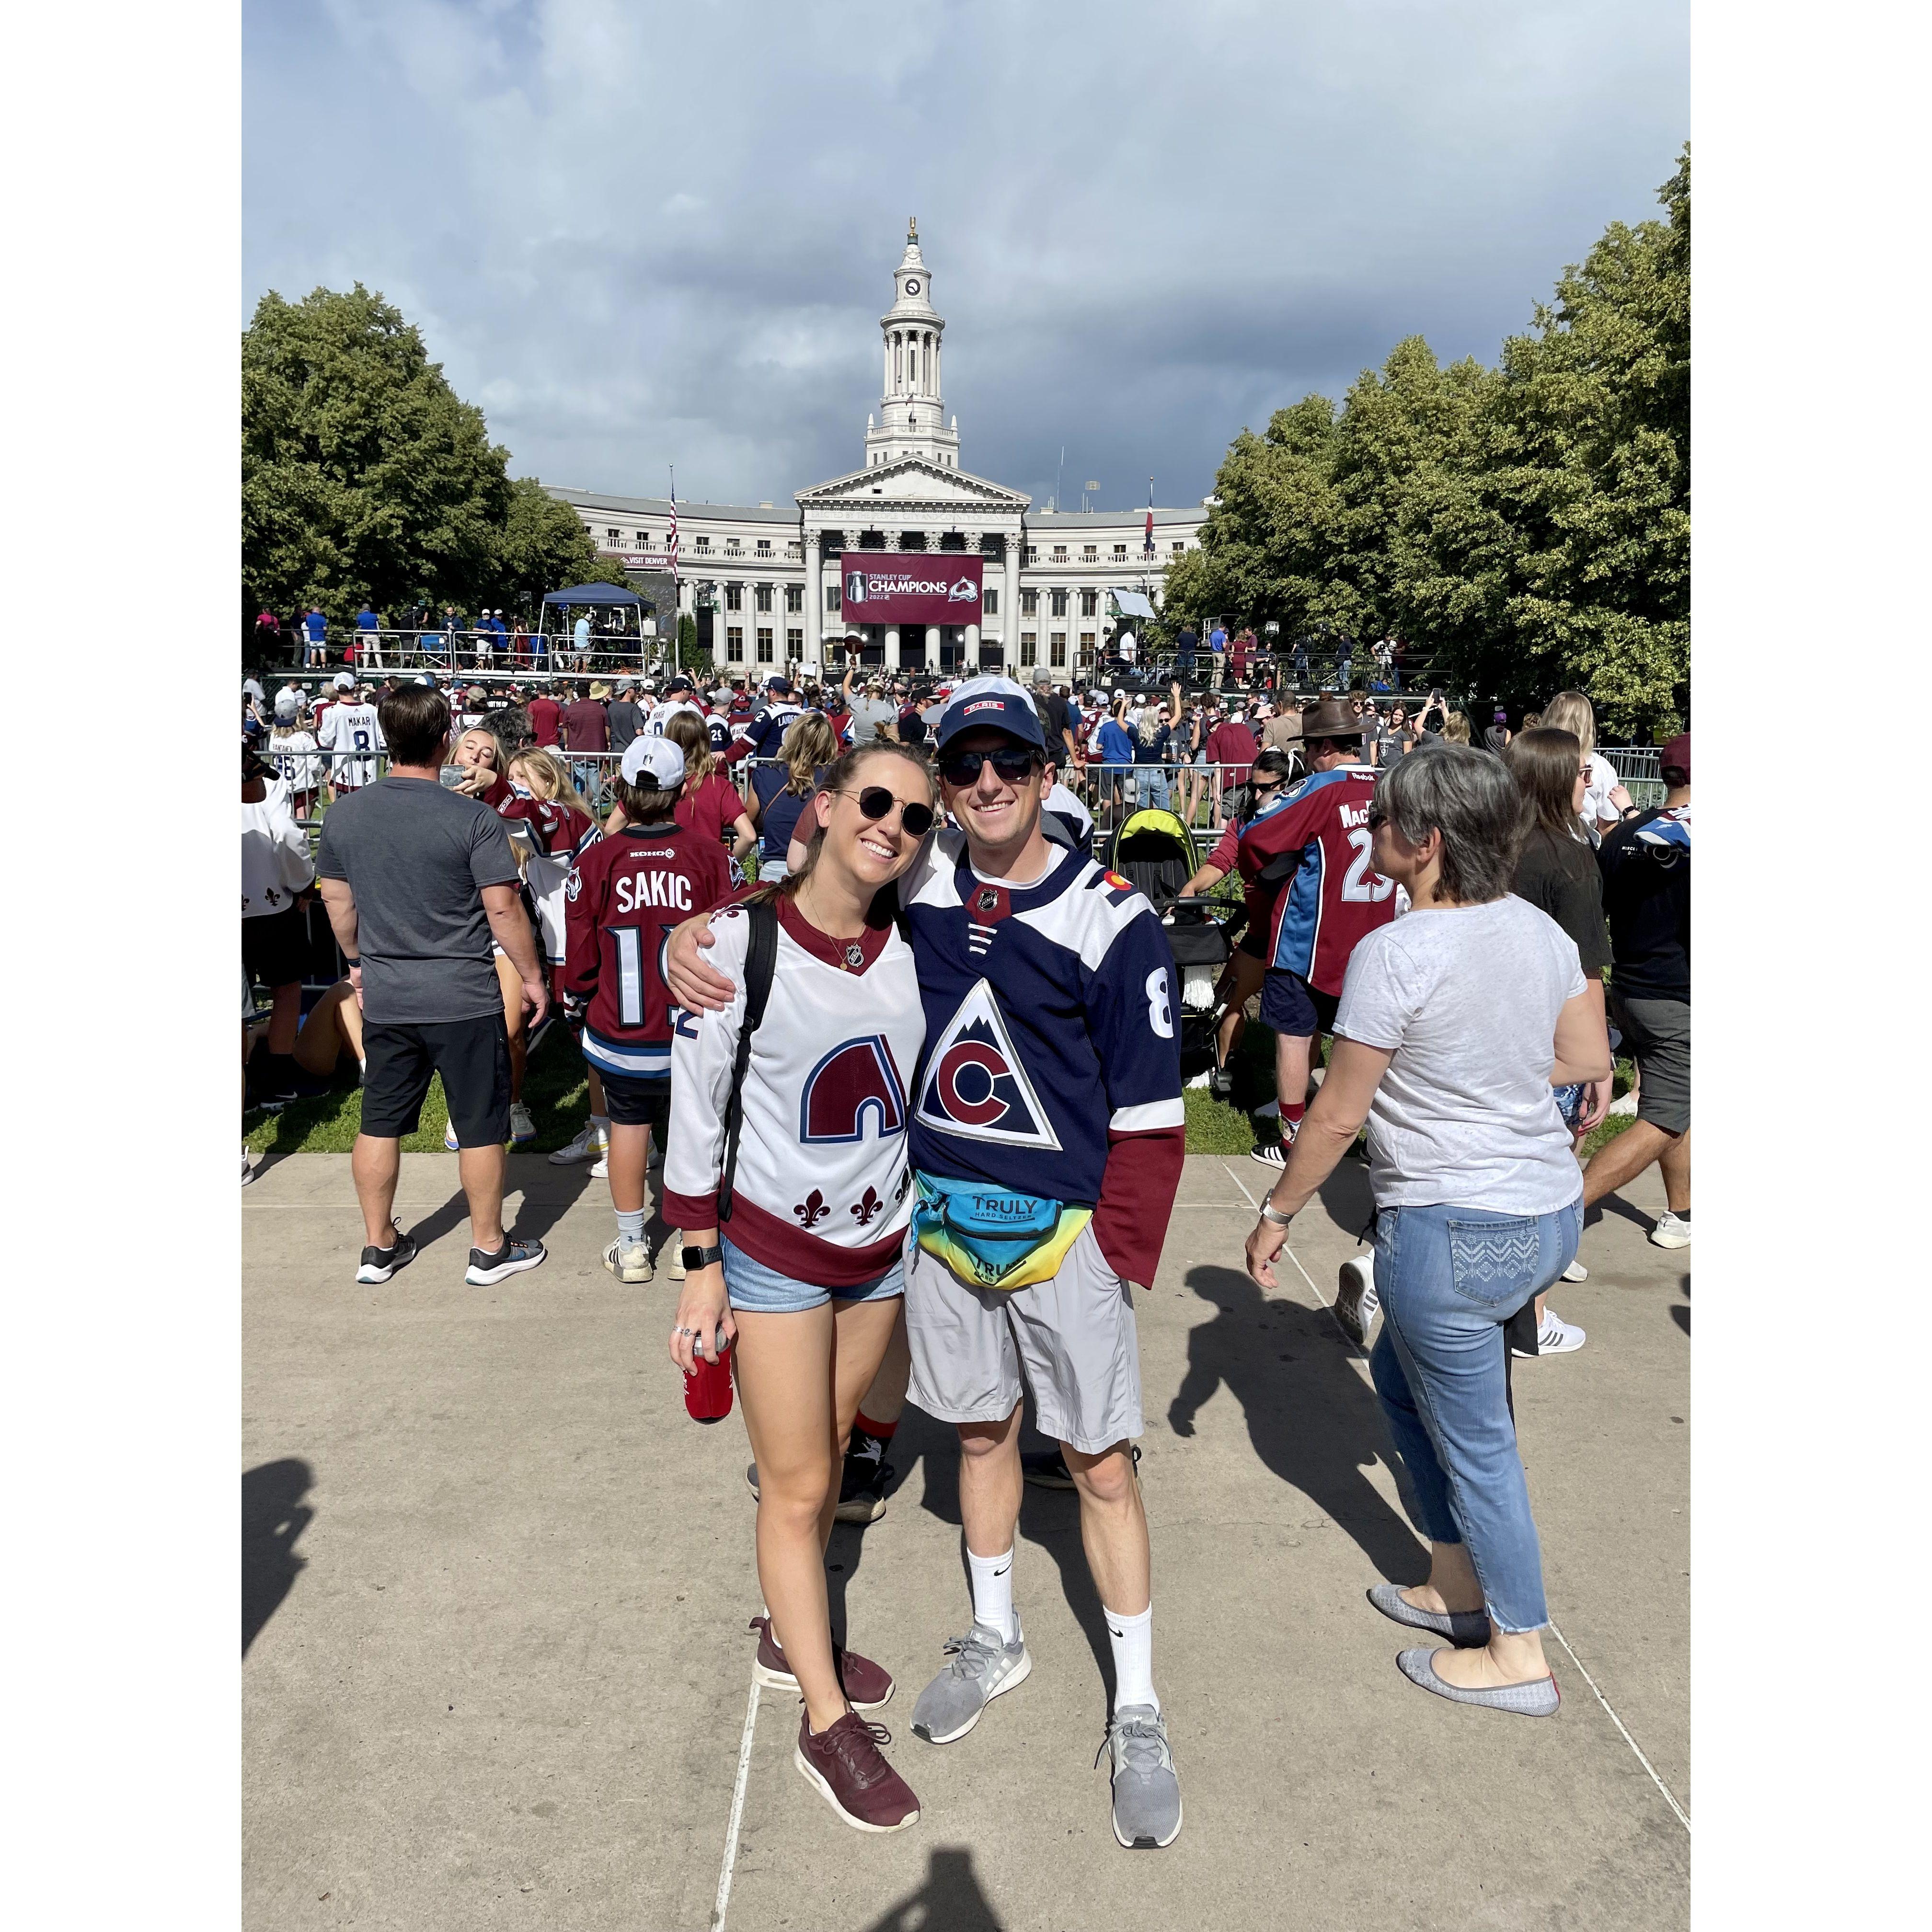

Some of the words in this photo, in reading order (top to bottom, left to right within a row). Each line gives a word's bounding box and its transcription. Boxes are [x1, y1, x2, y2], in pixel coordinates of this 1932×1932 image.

[869, 580, 947, 593] CHAMPIONS
[969, 702, 999, 712] PARIS
[348, 717, 370, 726] MAKAR
[354, 730, 371, 761] 8
[1351, 772, 1375, 781] Reebok
[616, 870, 692, 913] SAKIC
[1145, 966, 1174, 1038] 8
[972, 1196, 1038, 1214] TRULY
